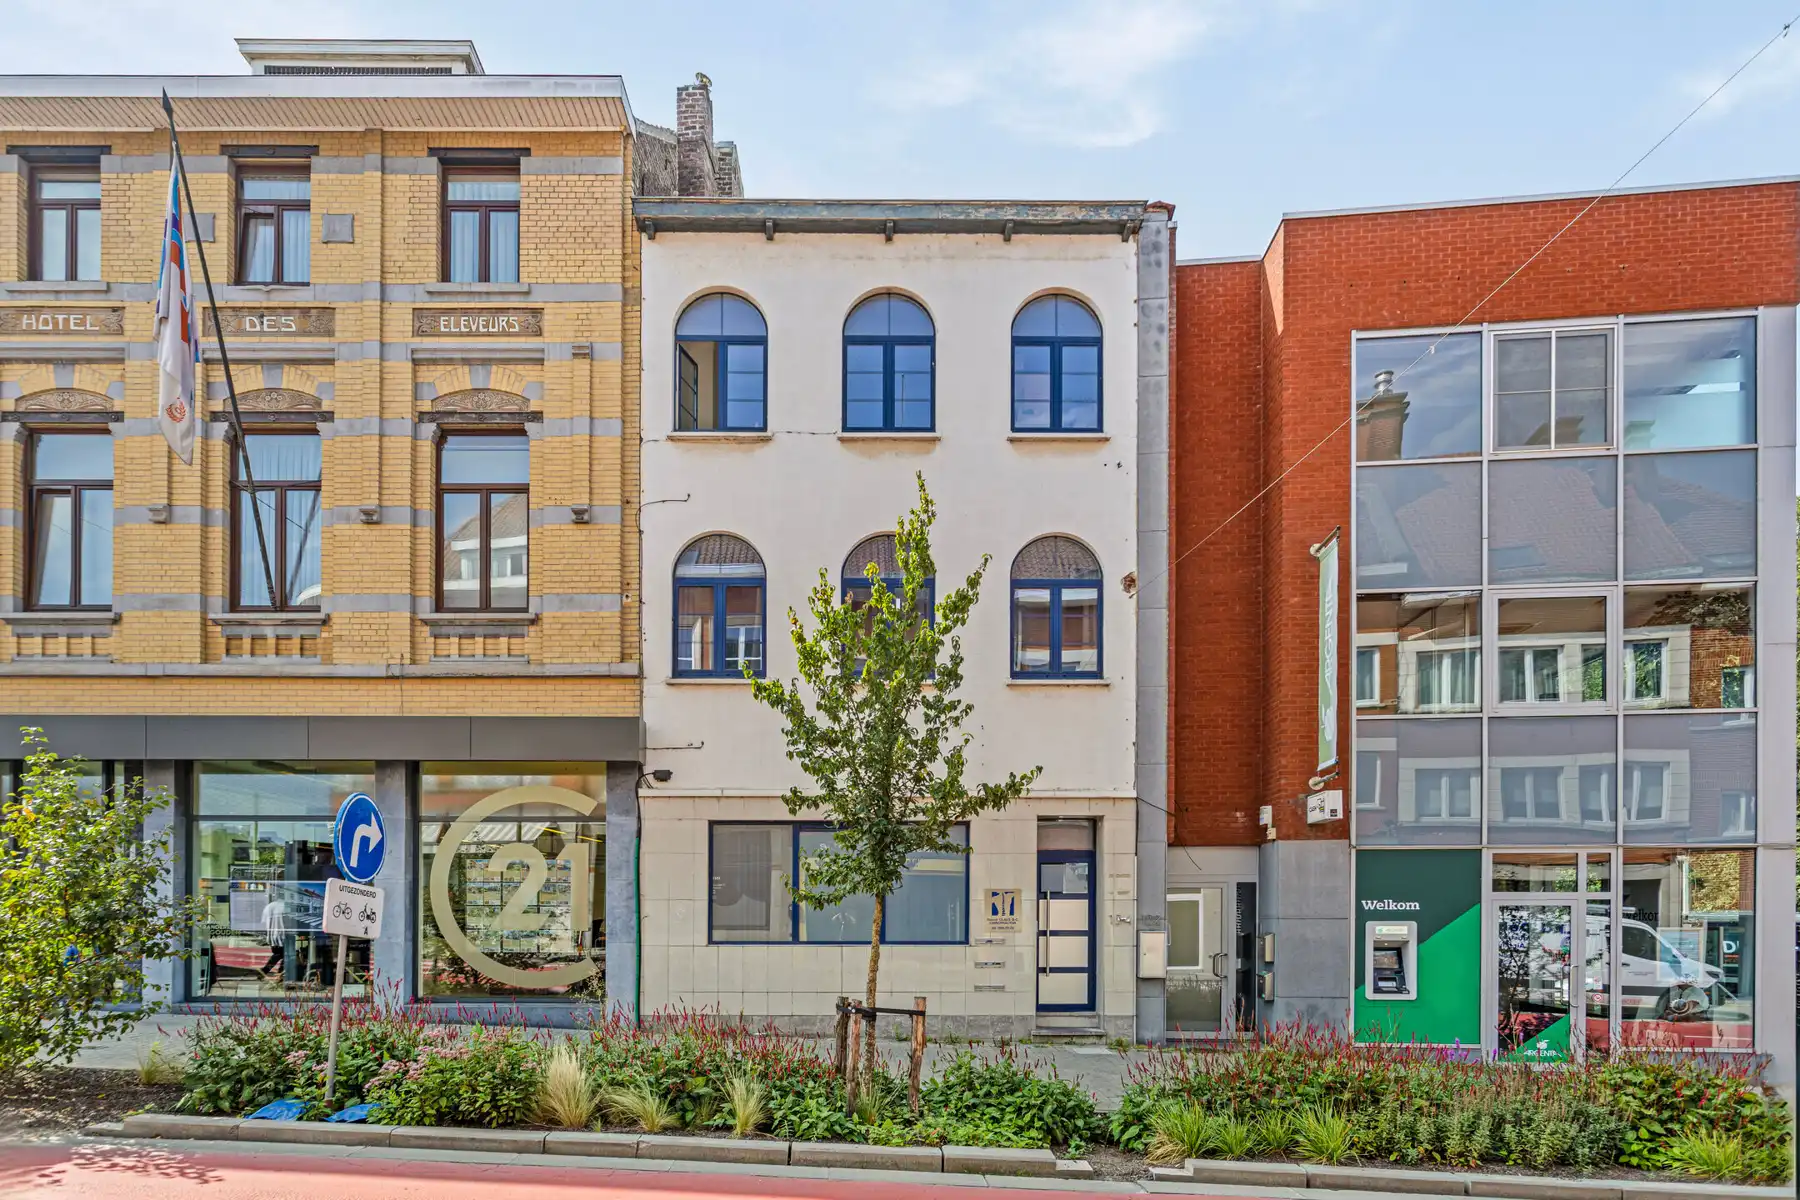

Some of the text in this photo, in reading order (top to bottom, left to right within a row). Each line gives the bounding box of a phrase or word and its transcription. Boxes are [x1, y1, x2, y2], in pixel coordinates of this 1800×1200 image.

[22, 314, 521, 333] HOTEL DES ELEVEURS
[339, 883, 377, 899] UITGEZONDERD
[1361, 899, 1420, 911] Welkom
[363, 926, 368, 936] A
[1523, 1049, 1562, 1058] ARGENTA
